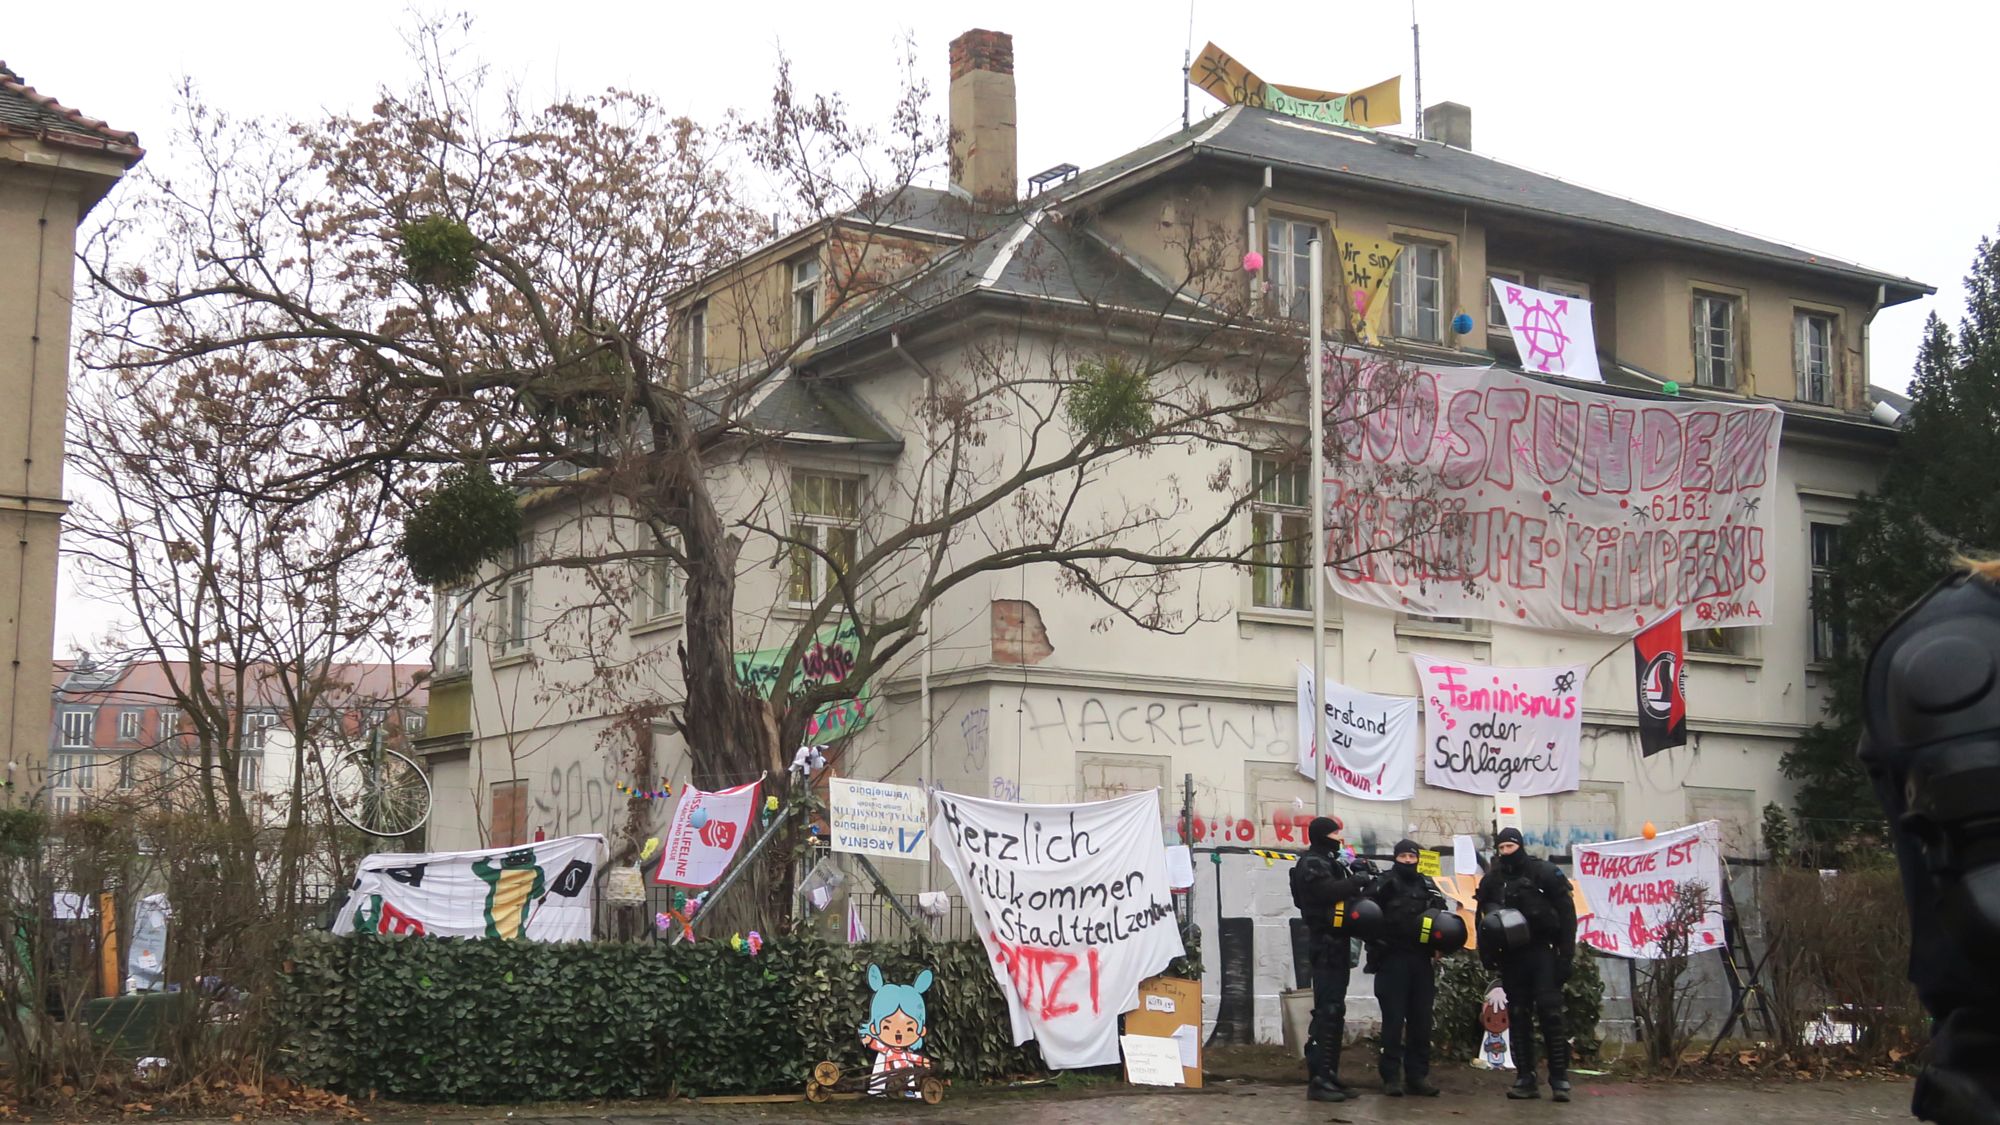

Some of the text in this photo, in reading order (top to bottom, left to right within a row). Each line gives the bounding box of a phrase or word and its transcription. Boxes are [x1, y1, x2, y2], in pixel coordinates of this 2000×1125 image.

[1440, 387, 1775, 493] STUNDEN
[1651, 493, 1711, 522] 6161
[1429, 666, 1576, 720] Feminismus
[1332, 729, 1352, 749] zu
[1470, 712, 1521, 742] oder
[1434, 735, 1557, 789] Schlägerei
[675, 824, 684, 836] AND
[840, 836, 894, 850] ARGENTA
[941, 800, 1100, 865] Herzlich
[670, 838, 680, 860] RESCUE
[676, 831, 693, 877] LIFELINE
[1580, 837, 1699, 880] ANARCHIE IST
[1608, 880, 1678, 906] MACHBAR
